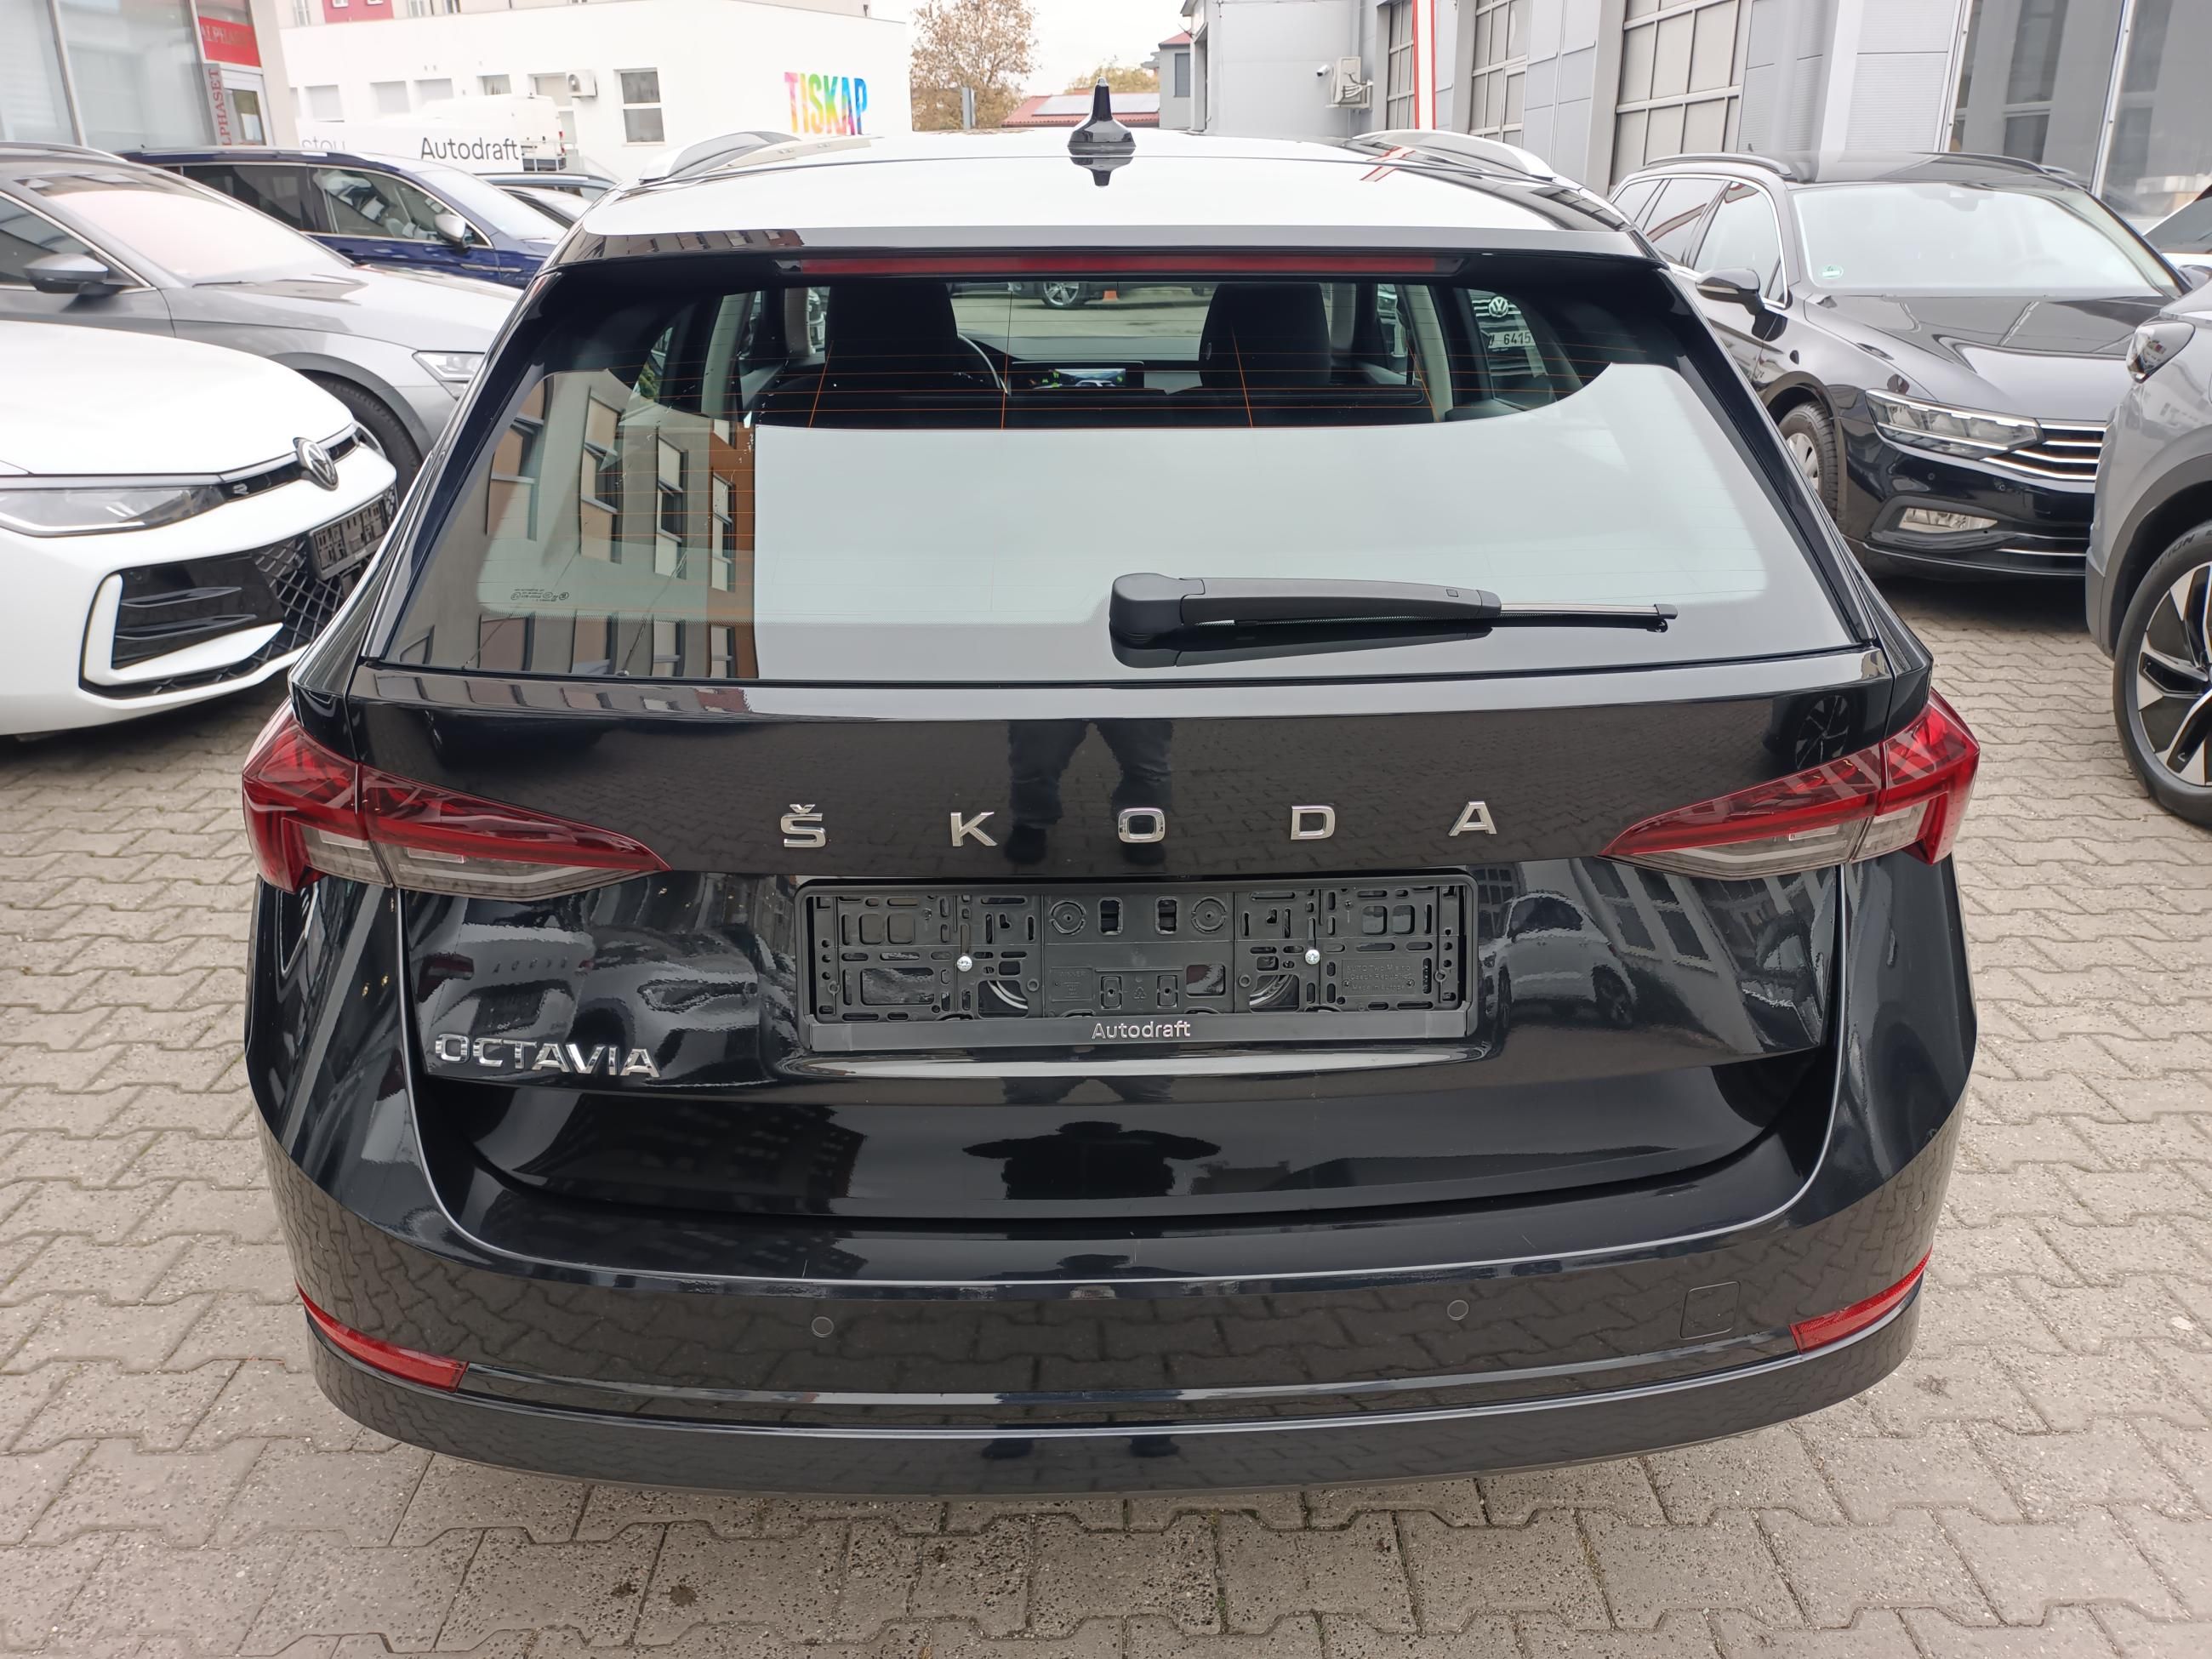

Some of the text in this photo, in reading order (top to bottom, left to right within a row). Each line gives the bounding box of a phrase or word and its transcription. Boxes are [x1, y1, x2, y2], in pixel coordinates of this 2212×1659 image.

[208, 68, 232, 145] LPHASET
[784, 71, 868, 136] TISKAP
[420, 137, 520, 160] Autodraft
[780, 802, 1497, 849] ŠKODA
[1091, 1020, 1191, 1040] Autodraft
[435, 1033, 661, 1079] OCTAVIA
